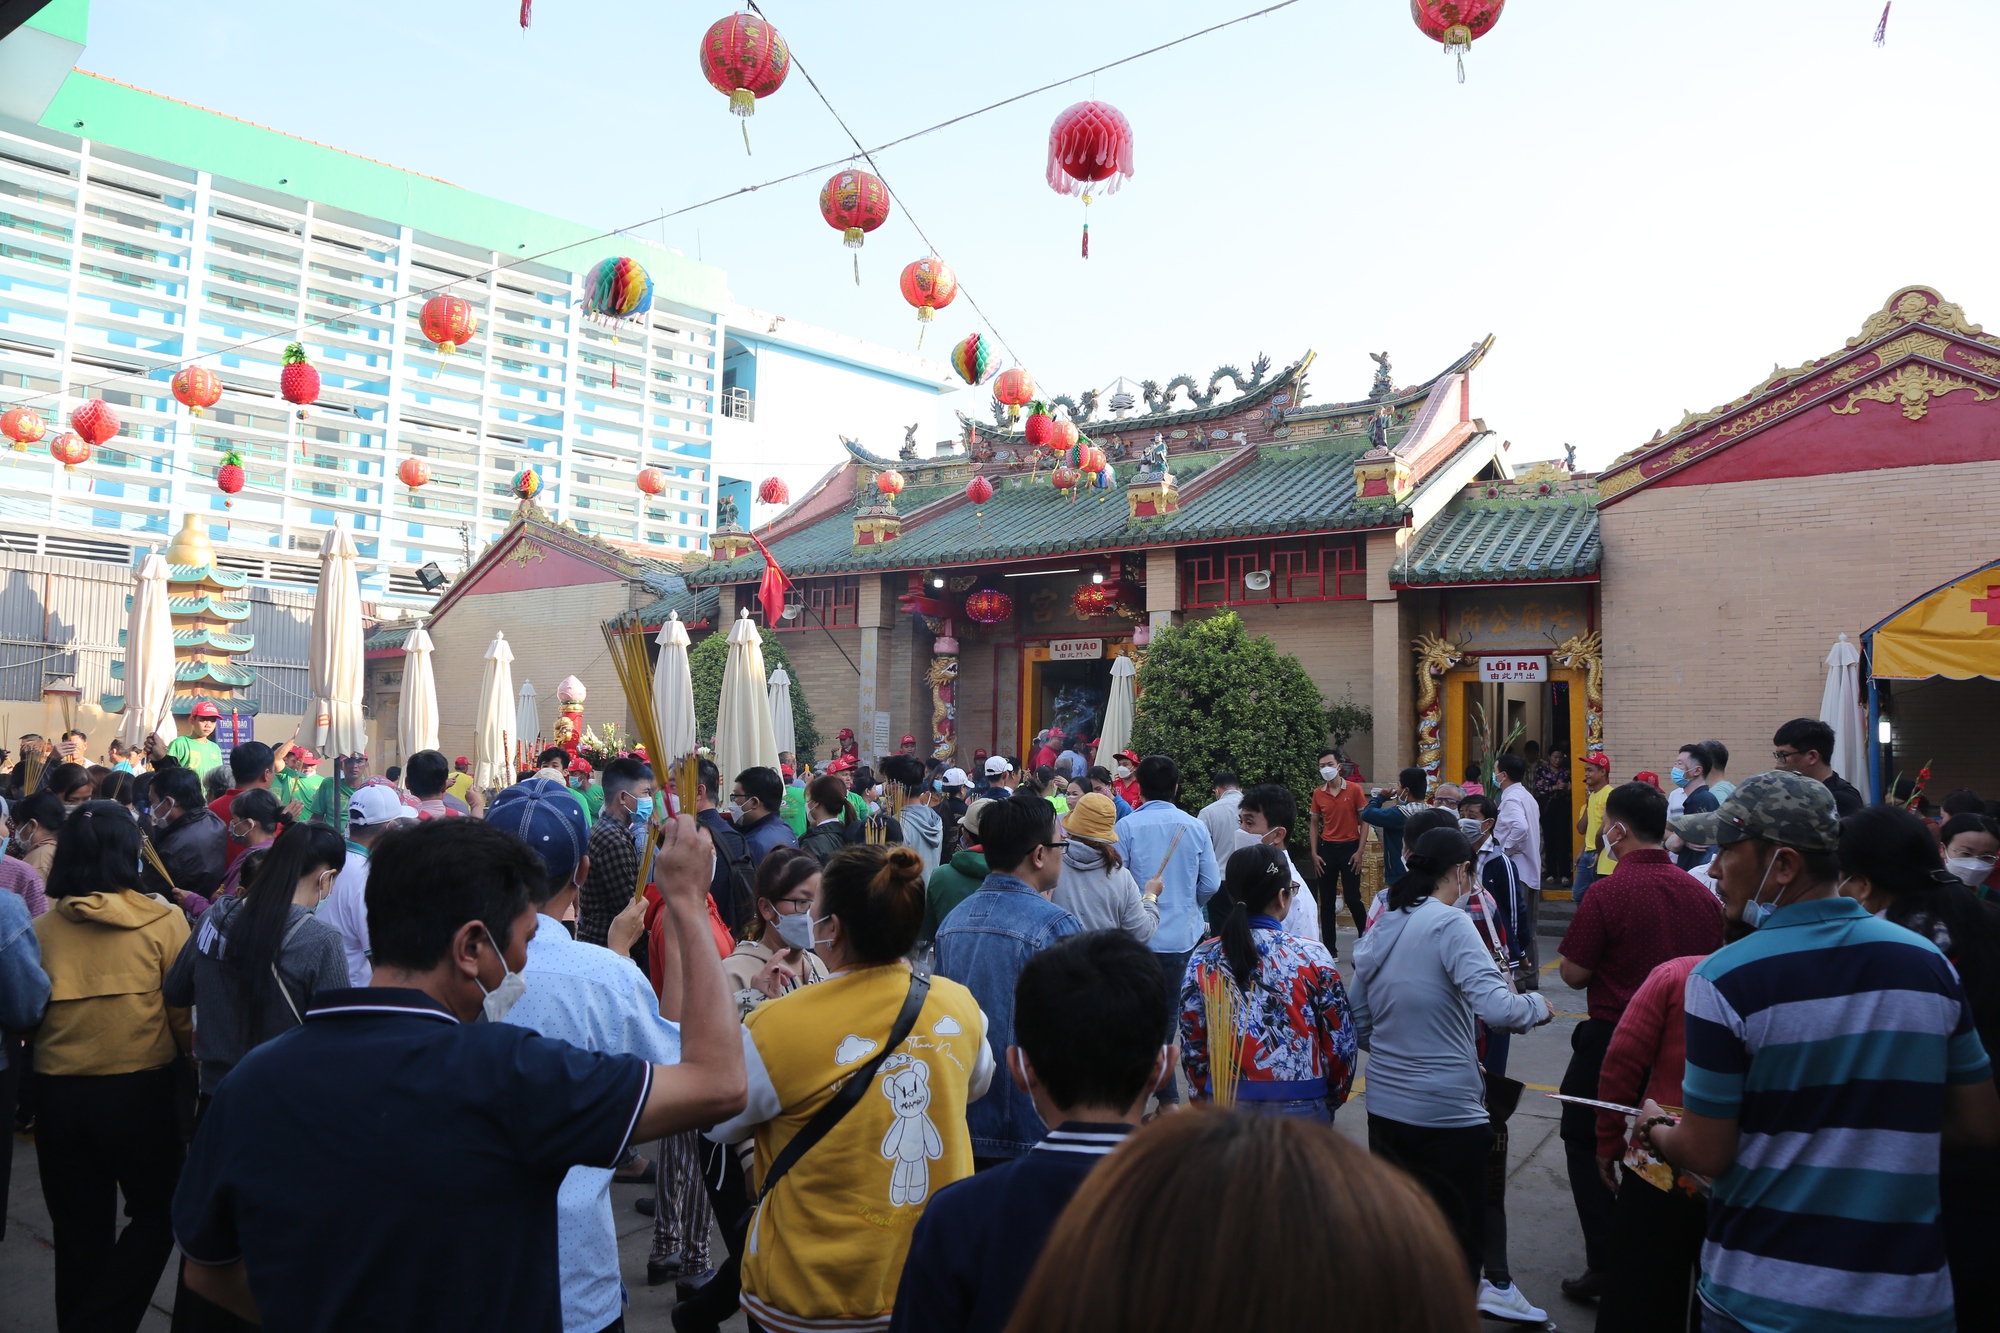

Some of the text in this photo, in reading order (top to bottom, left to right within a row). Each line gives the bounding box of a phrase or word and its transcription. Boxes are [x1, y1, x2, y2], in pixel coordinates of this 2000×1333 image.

[1054, 641, 1098, 652] LỐI VÀO
[1486, 659, 1540, 671] LỐI RA
